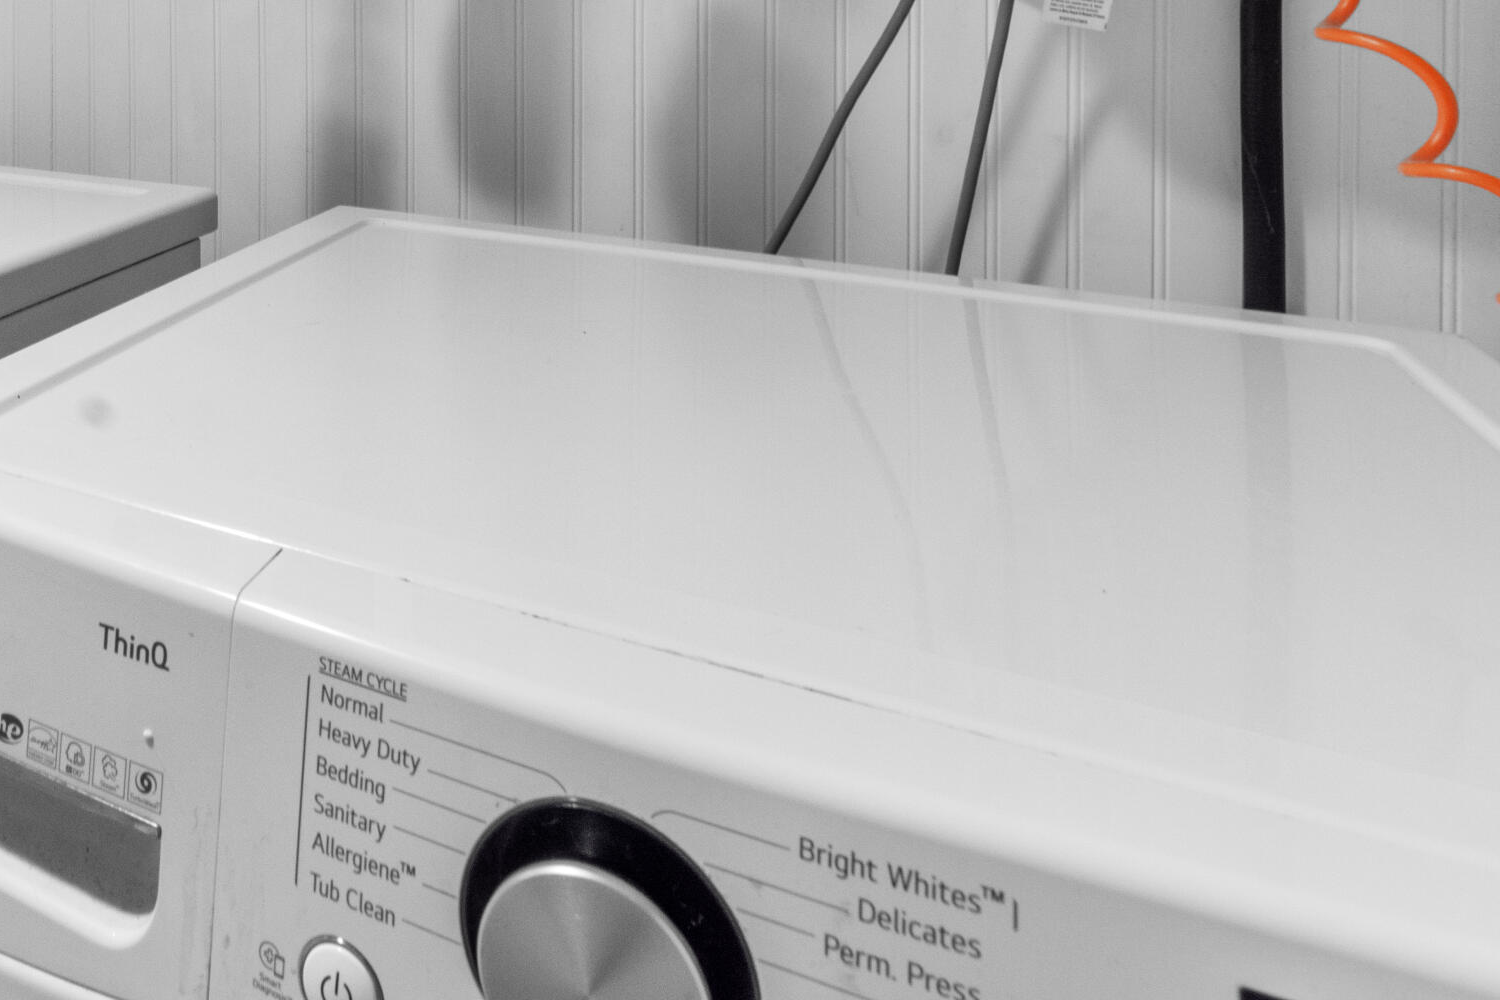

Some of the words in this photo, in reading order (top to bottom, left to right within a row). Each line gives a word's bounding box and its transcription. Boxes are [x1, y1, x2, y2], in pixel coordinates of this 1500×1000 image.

[99, 621, 171, 672] ThinQ
[319, 656, 364, 685] STEAM
[366, 671, 409, 699] CYCLE
[321, 683, 385, 724] Normal
[318, 717, 371, 759] Heavy
[377, 737, 421, 775] Duty
[316, 755, 387, 805] Bedding
[314, 793, 387, 843] Sanitary
[312, 831, 417, 886] Allergiene™
[798, 836, 878, 883] Bright
[888, 862, 1006, 915] Whites™
[310, 871, 340, 903] Tub
[346, 888, 396, 927] Clean
[858, 897, 982, 959] Delicates
[823, 933, 897, 982] Perm.
[908, 960, 981, 1000] Press
